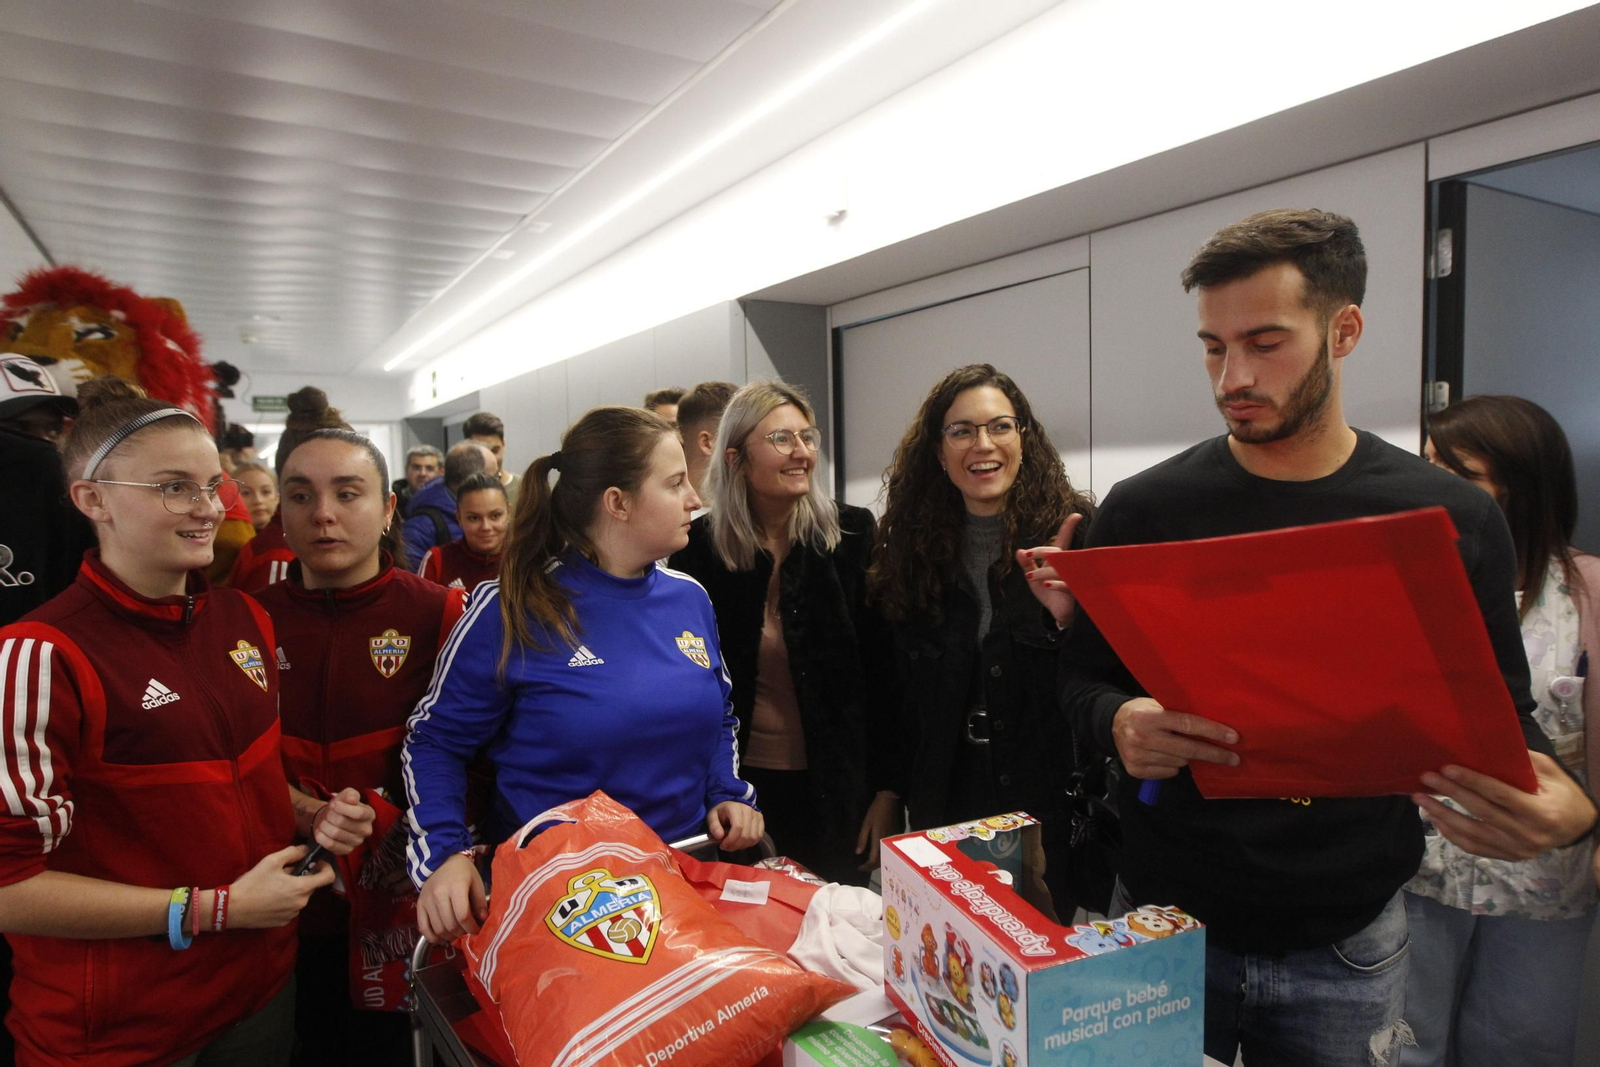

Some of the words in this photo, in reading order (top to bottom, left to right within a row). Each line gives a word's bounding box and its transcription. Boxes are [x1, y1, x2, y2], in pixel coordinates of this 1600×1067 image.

[568, 658, 605, 667] adidas
[142, 692, 181, 710] adidas
[570, 892, 653, 934] ALMERIA
[951, 880, 1057, 957] Aprendizaje
[1044, 1016, 1109, 1051] musical
[1113, 1011, 1142, 1030] con
[1147, 996, 1191, 1025] piano
[1062, 997, 1122, 1025] Parque
[1126, 979, 1169, 1007] bebé
[645, 1019, 716, 1067] Deportiva
[716, 985, 770, 1025] Almería
